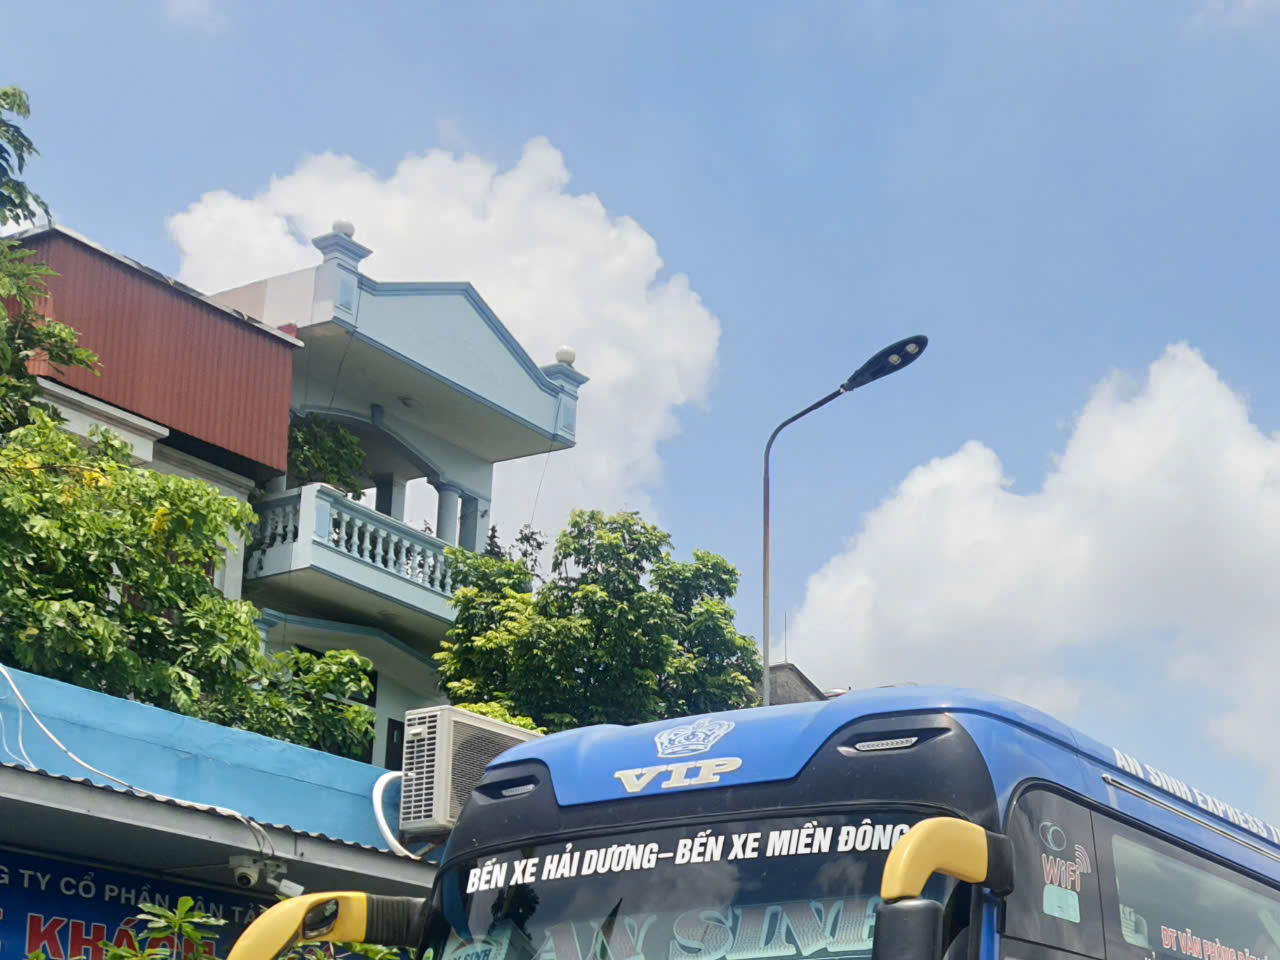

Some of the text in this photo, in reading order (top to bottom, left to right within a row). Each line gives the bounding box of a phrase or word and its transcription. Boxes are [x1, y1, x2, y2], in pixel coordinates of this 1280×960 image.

[614, 757, 742, 793] VIP
[466, 857, 508, 893] BẾN
[509, 857, 540, 886] XE
[541, 842, 580, 881] HẢI
[727, 832, 761, 861] XE
[765, 820, 834, 857] MIỀN
[19, 868, 51, 891] TY
[60, 871, 96, 898] CỔ
[104, 884, 170, 908] PHẦN
[231, 902, 257, 924] TẢ
[1161, 925, 1177, 951] ĐT
[1178, 928, 1202, 959] VĂN
